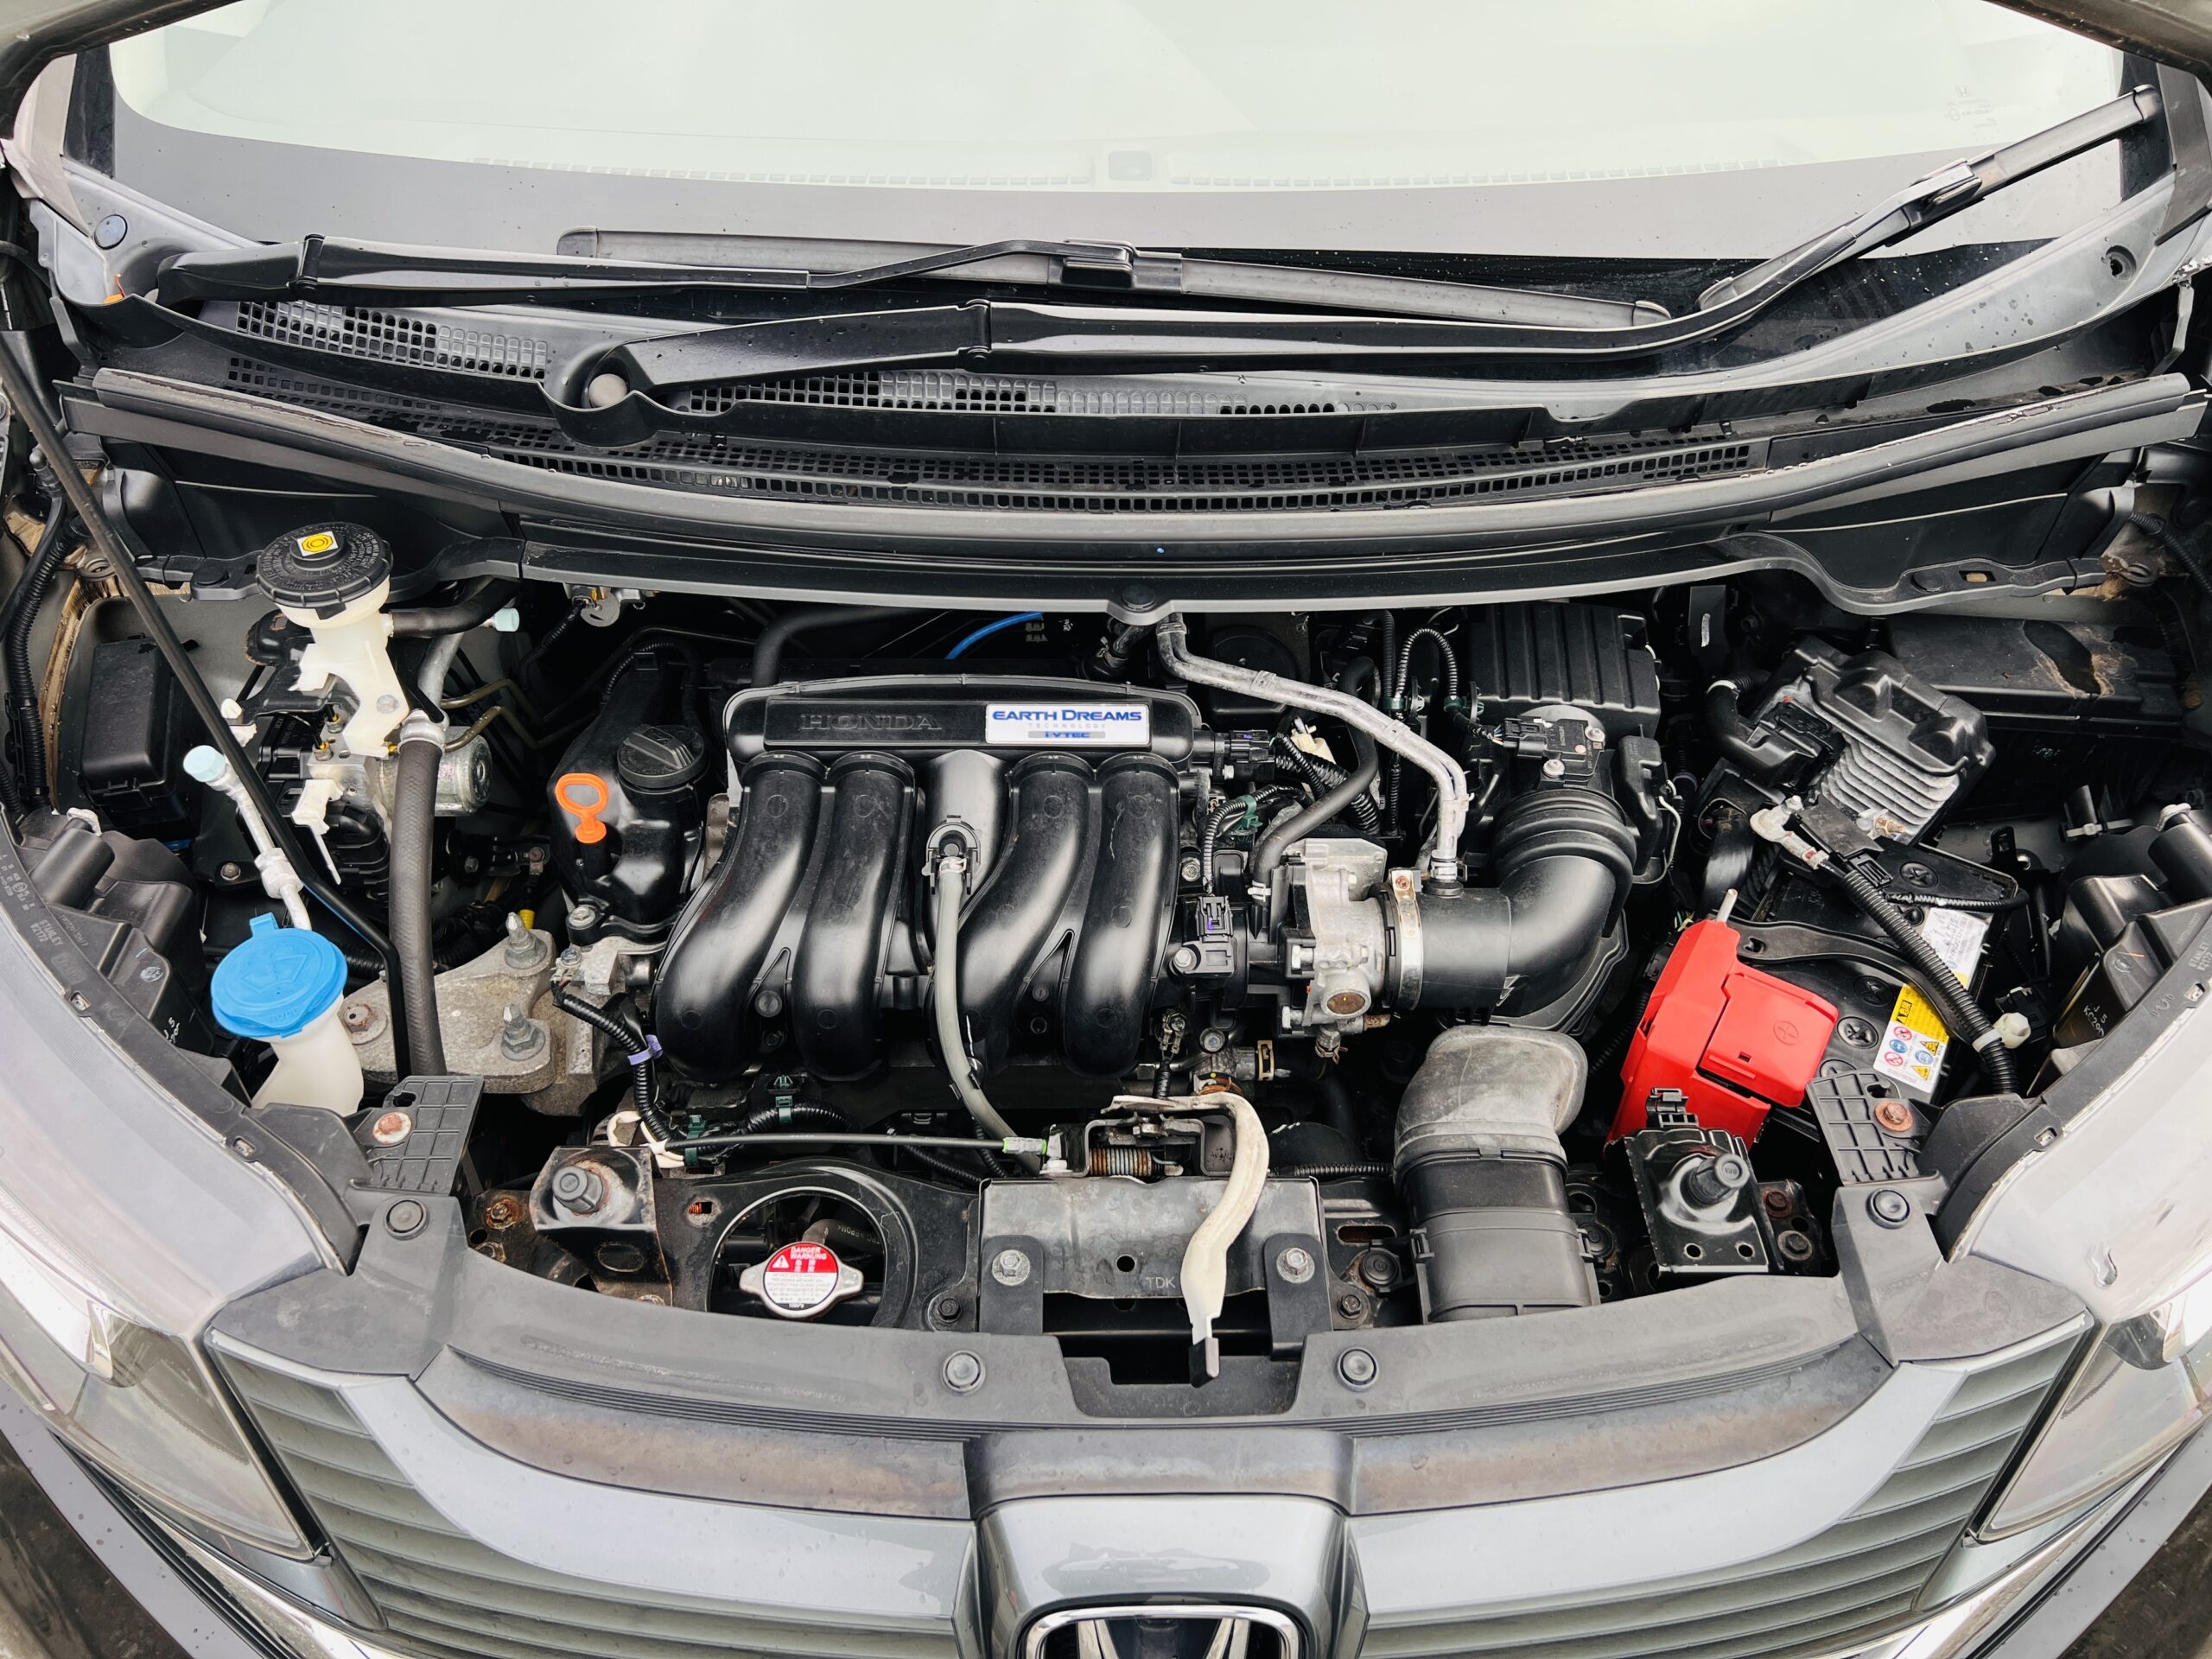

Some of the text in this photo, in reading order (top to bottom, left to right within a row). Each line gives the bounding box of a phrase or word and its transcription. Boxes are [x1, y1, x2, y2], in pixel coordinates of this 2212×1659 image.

[799, 713, 943, 731] HONDA
[992, 709, 1142, 721] EARTH DREAMS
[39, 919, 64, 946] STANLEY
[1146, 1275, 1176, 1289] TDK
